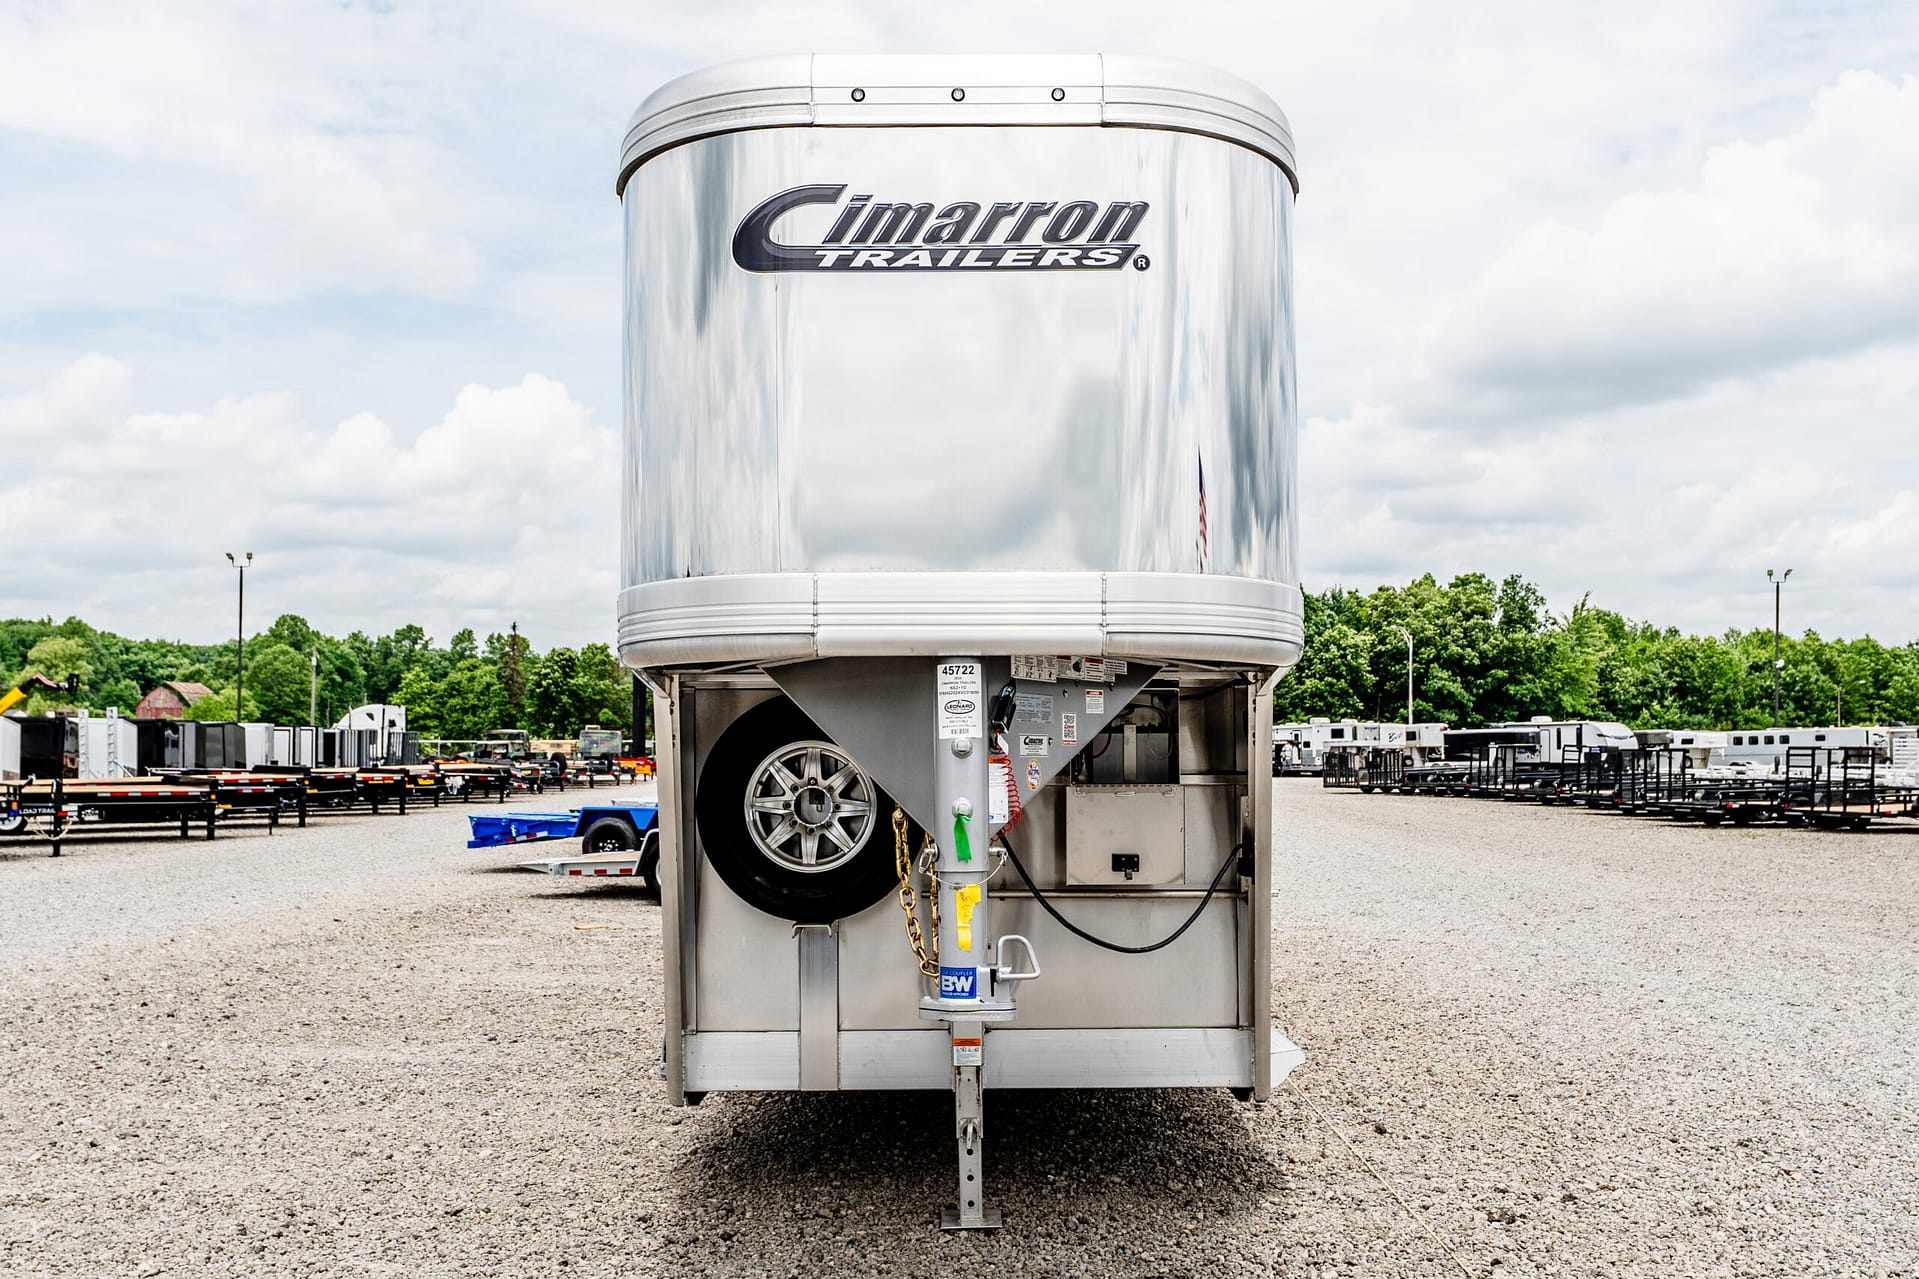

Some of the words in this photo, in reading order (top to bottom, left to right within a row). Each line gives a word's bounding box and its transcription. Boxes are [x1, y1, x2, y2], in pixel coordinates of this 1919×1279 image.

[732, 184, 1150, 272] Cimarron
[814, 249, 1125, 268] TRAILERS
[942, 665, 975, 676] 45722
